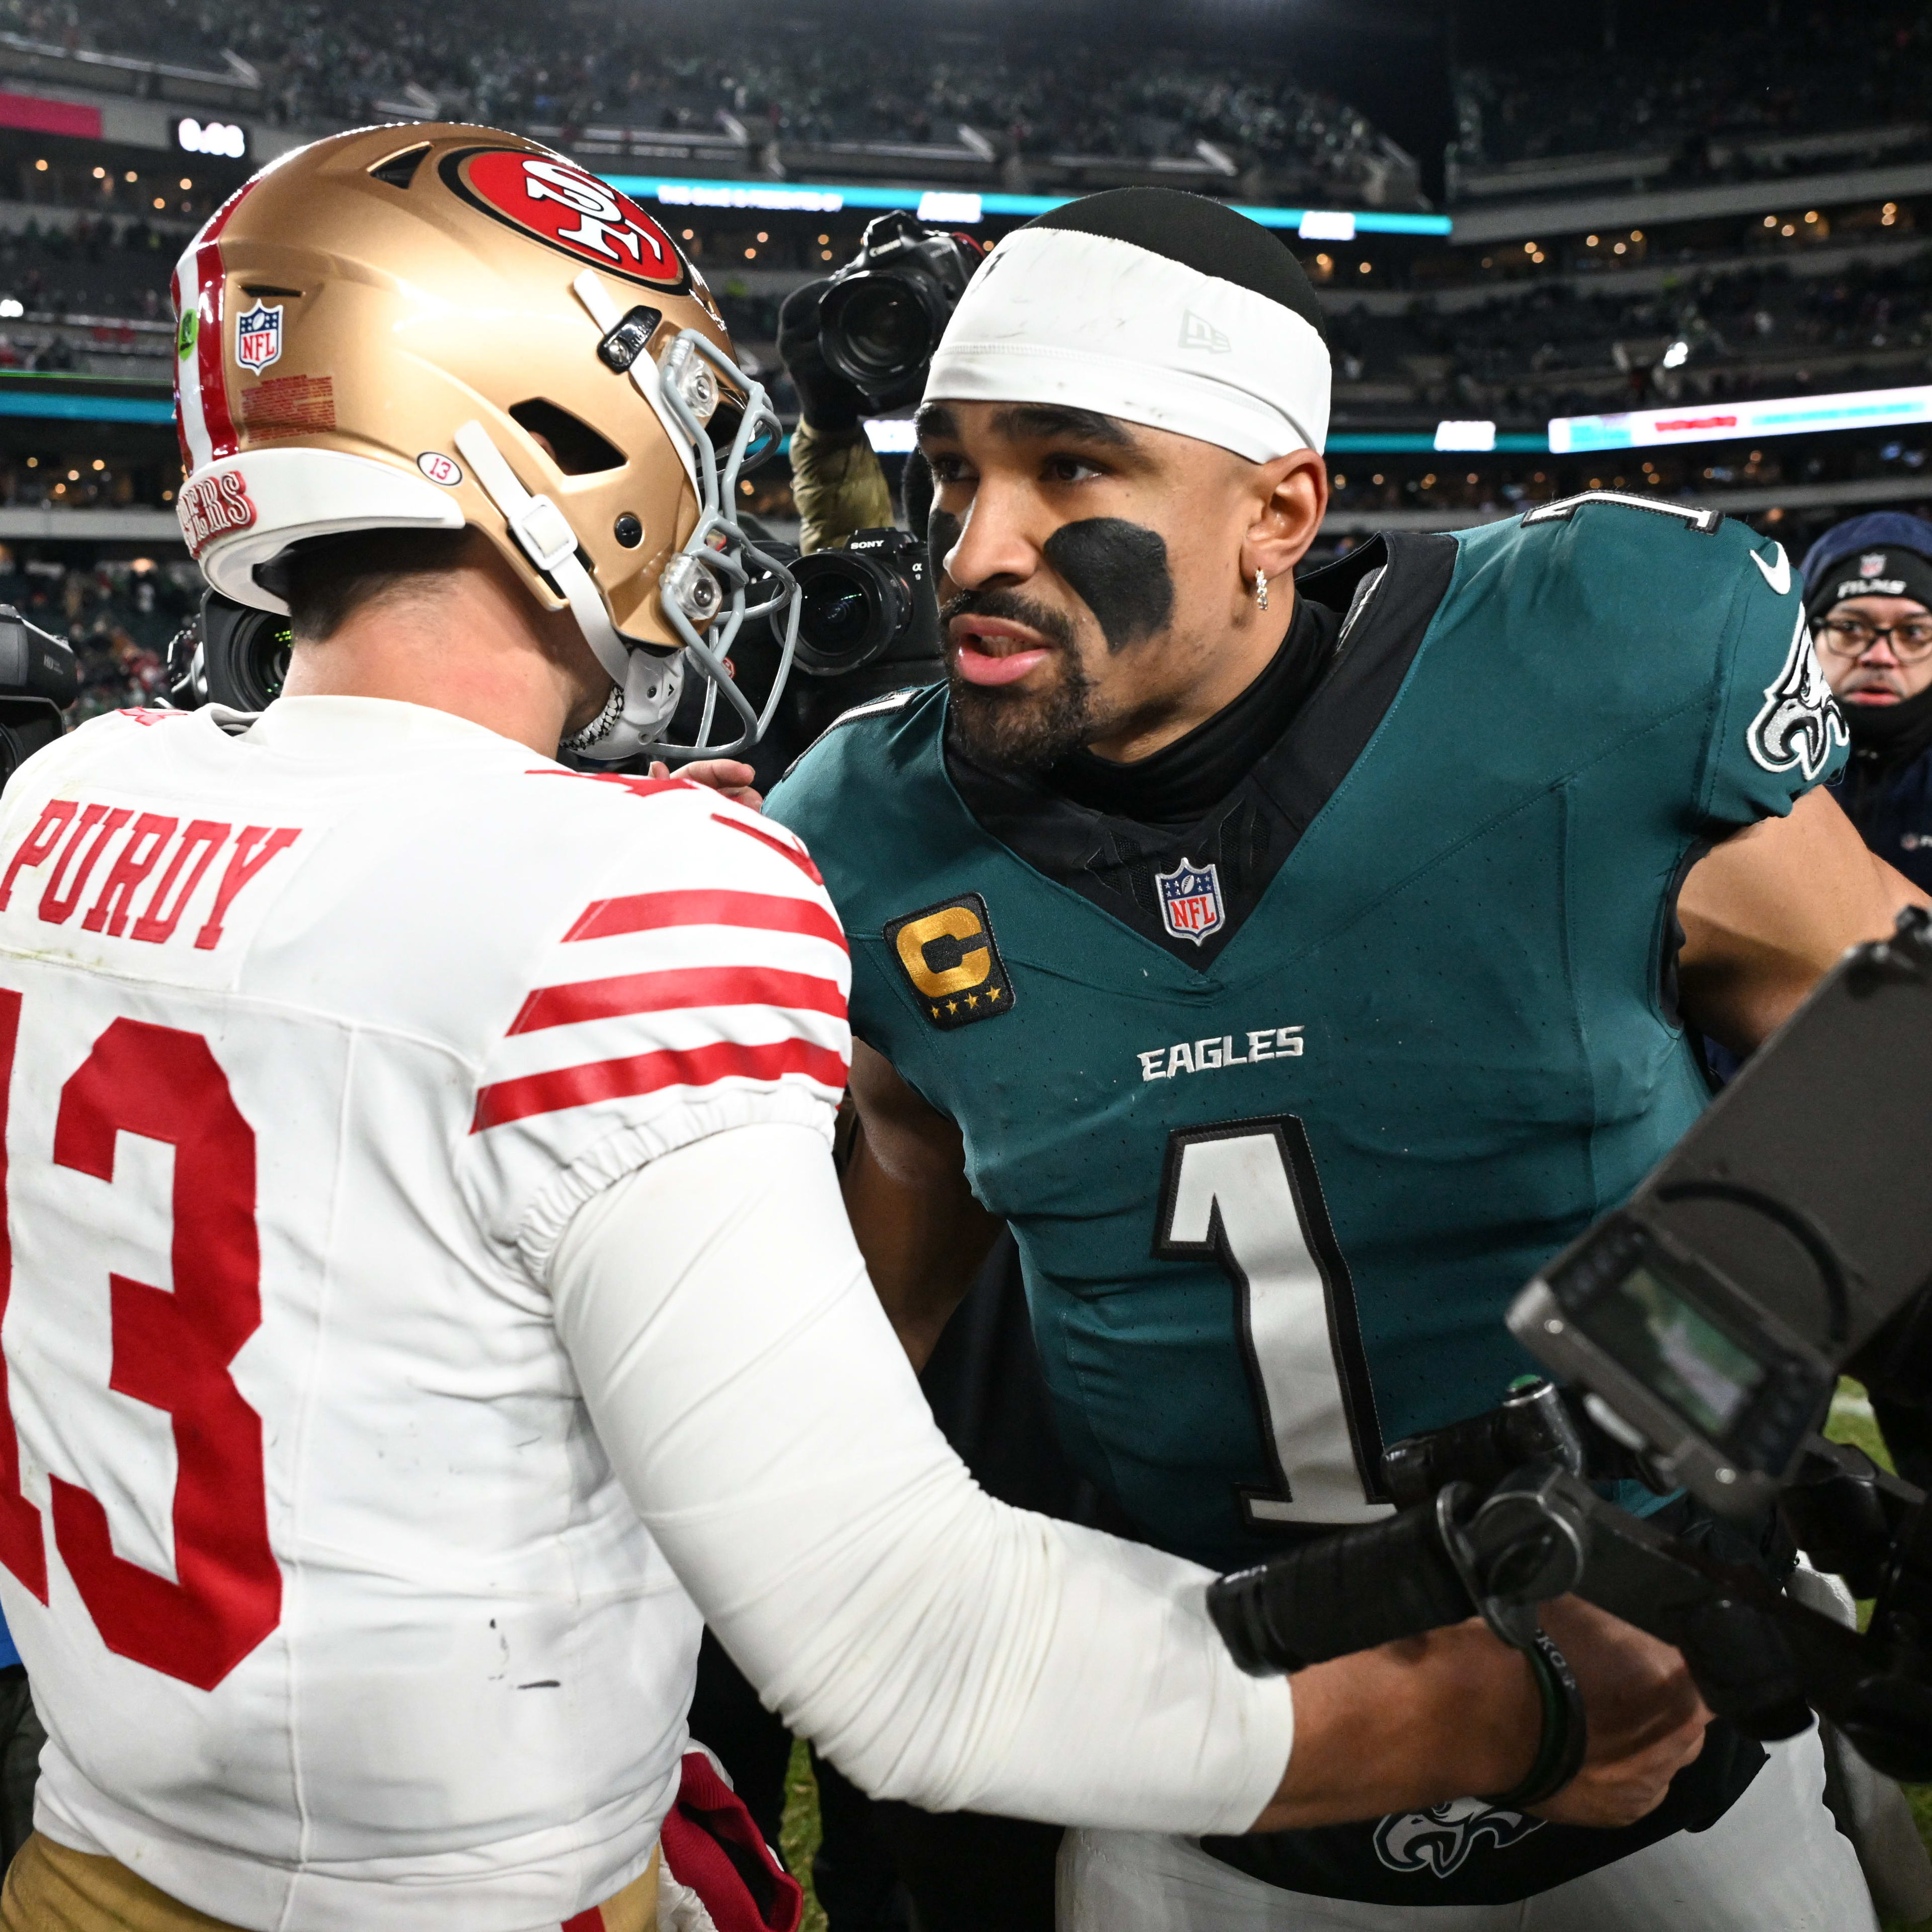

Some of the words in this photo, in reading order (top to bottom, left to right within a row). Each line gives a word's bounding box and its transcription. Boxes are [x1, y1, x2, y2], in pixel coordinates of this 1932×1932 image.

[522, 160, 664, 263] SF
[242, 333, 275, 362] NFL
[430, 458, 451, 479] 13
[851, 540, 884, 549] SONY
[0, 799, 302, 951] PURDY
[1171, 897, 1215, 929] NFL
[897, 907, 991, 998] C
[1137, 1025, 1305, 1082] EAGLES
[1163, 1125, 1401, 1527] 1
